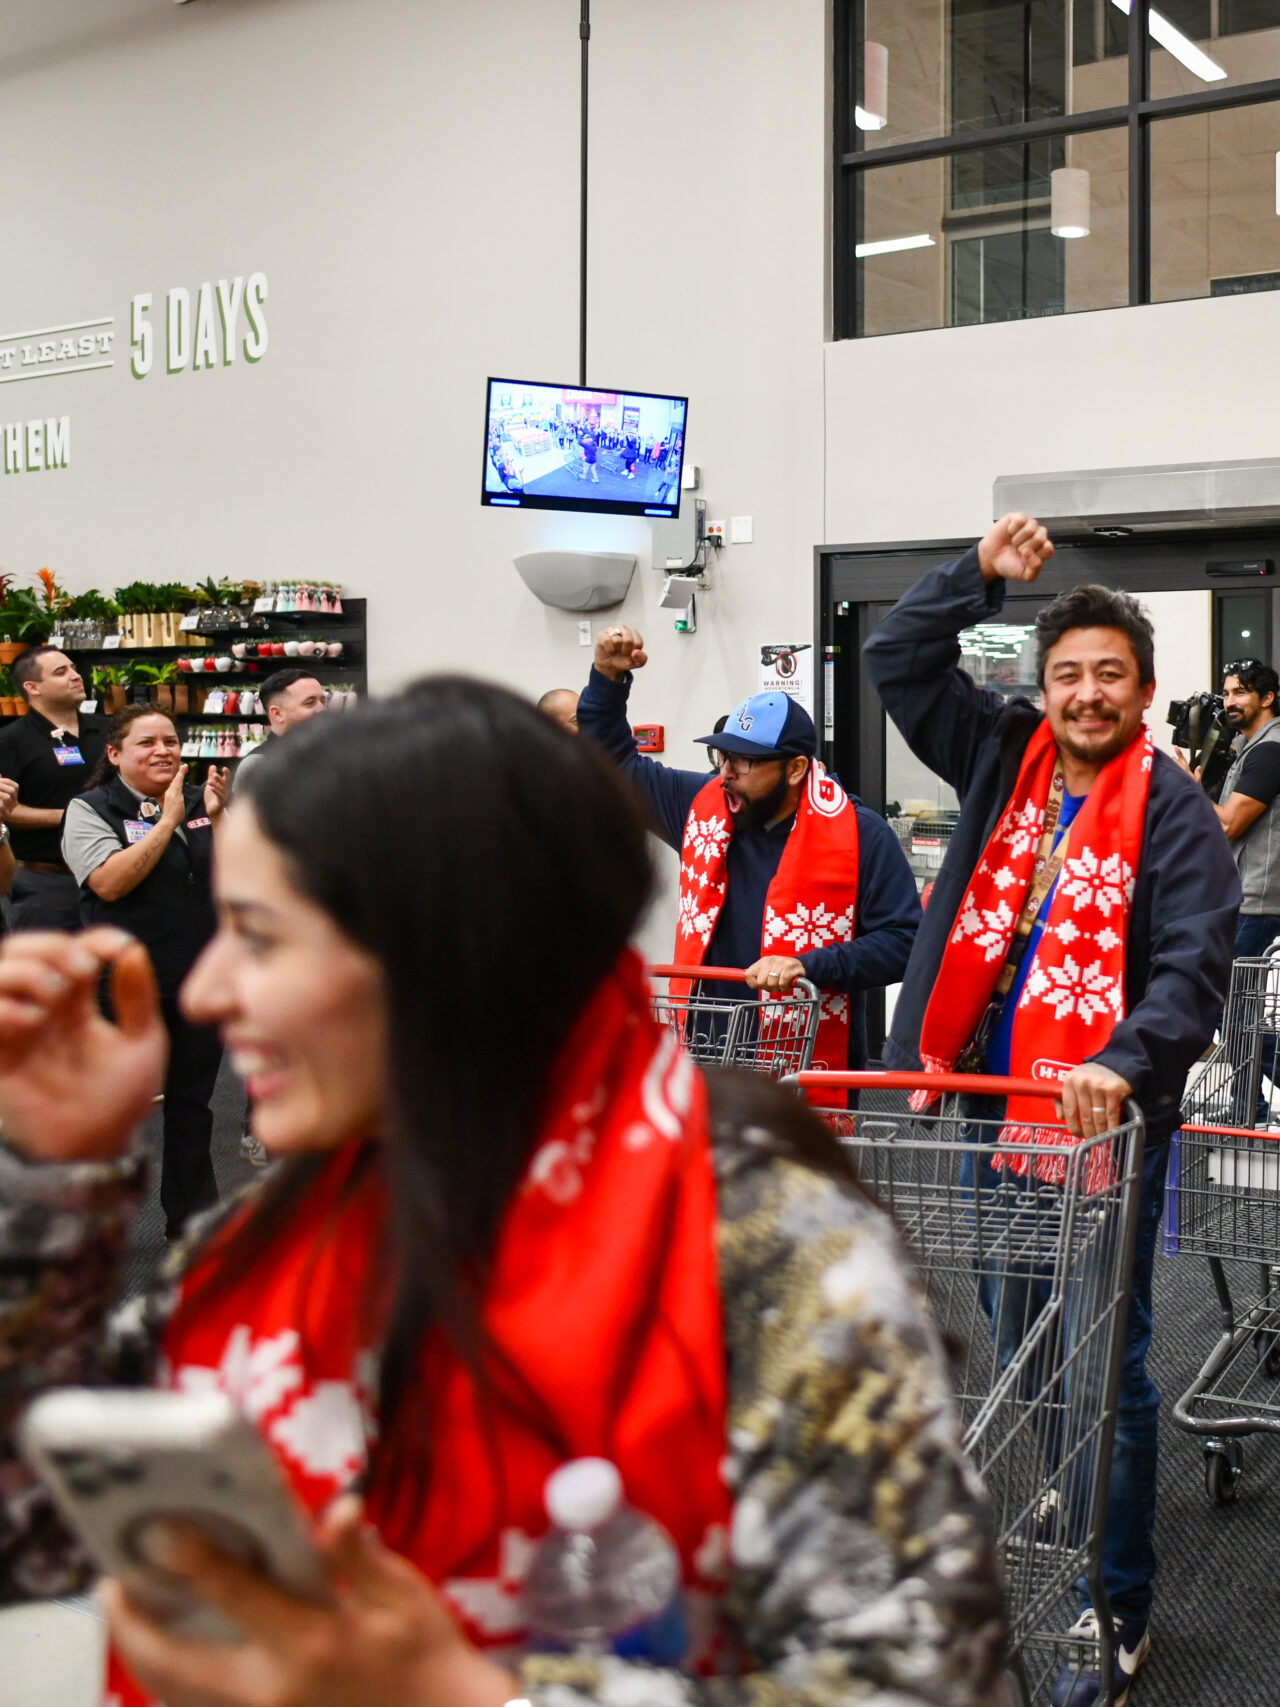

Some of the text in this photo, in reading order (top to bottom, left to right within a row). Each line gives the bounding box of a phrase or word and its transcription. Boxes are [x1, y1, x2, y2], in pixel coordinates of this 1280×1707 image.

[0, 332, 114, 370] T LEAST
[131, 272, 269, 380] 5 DAYS
[0, 415, 71, 475] HEM
